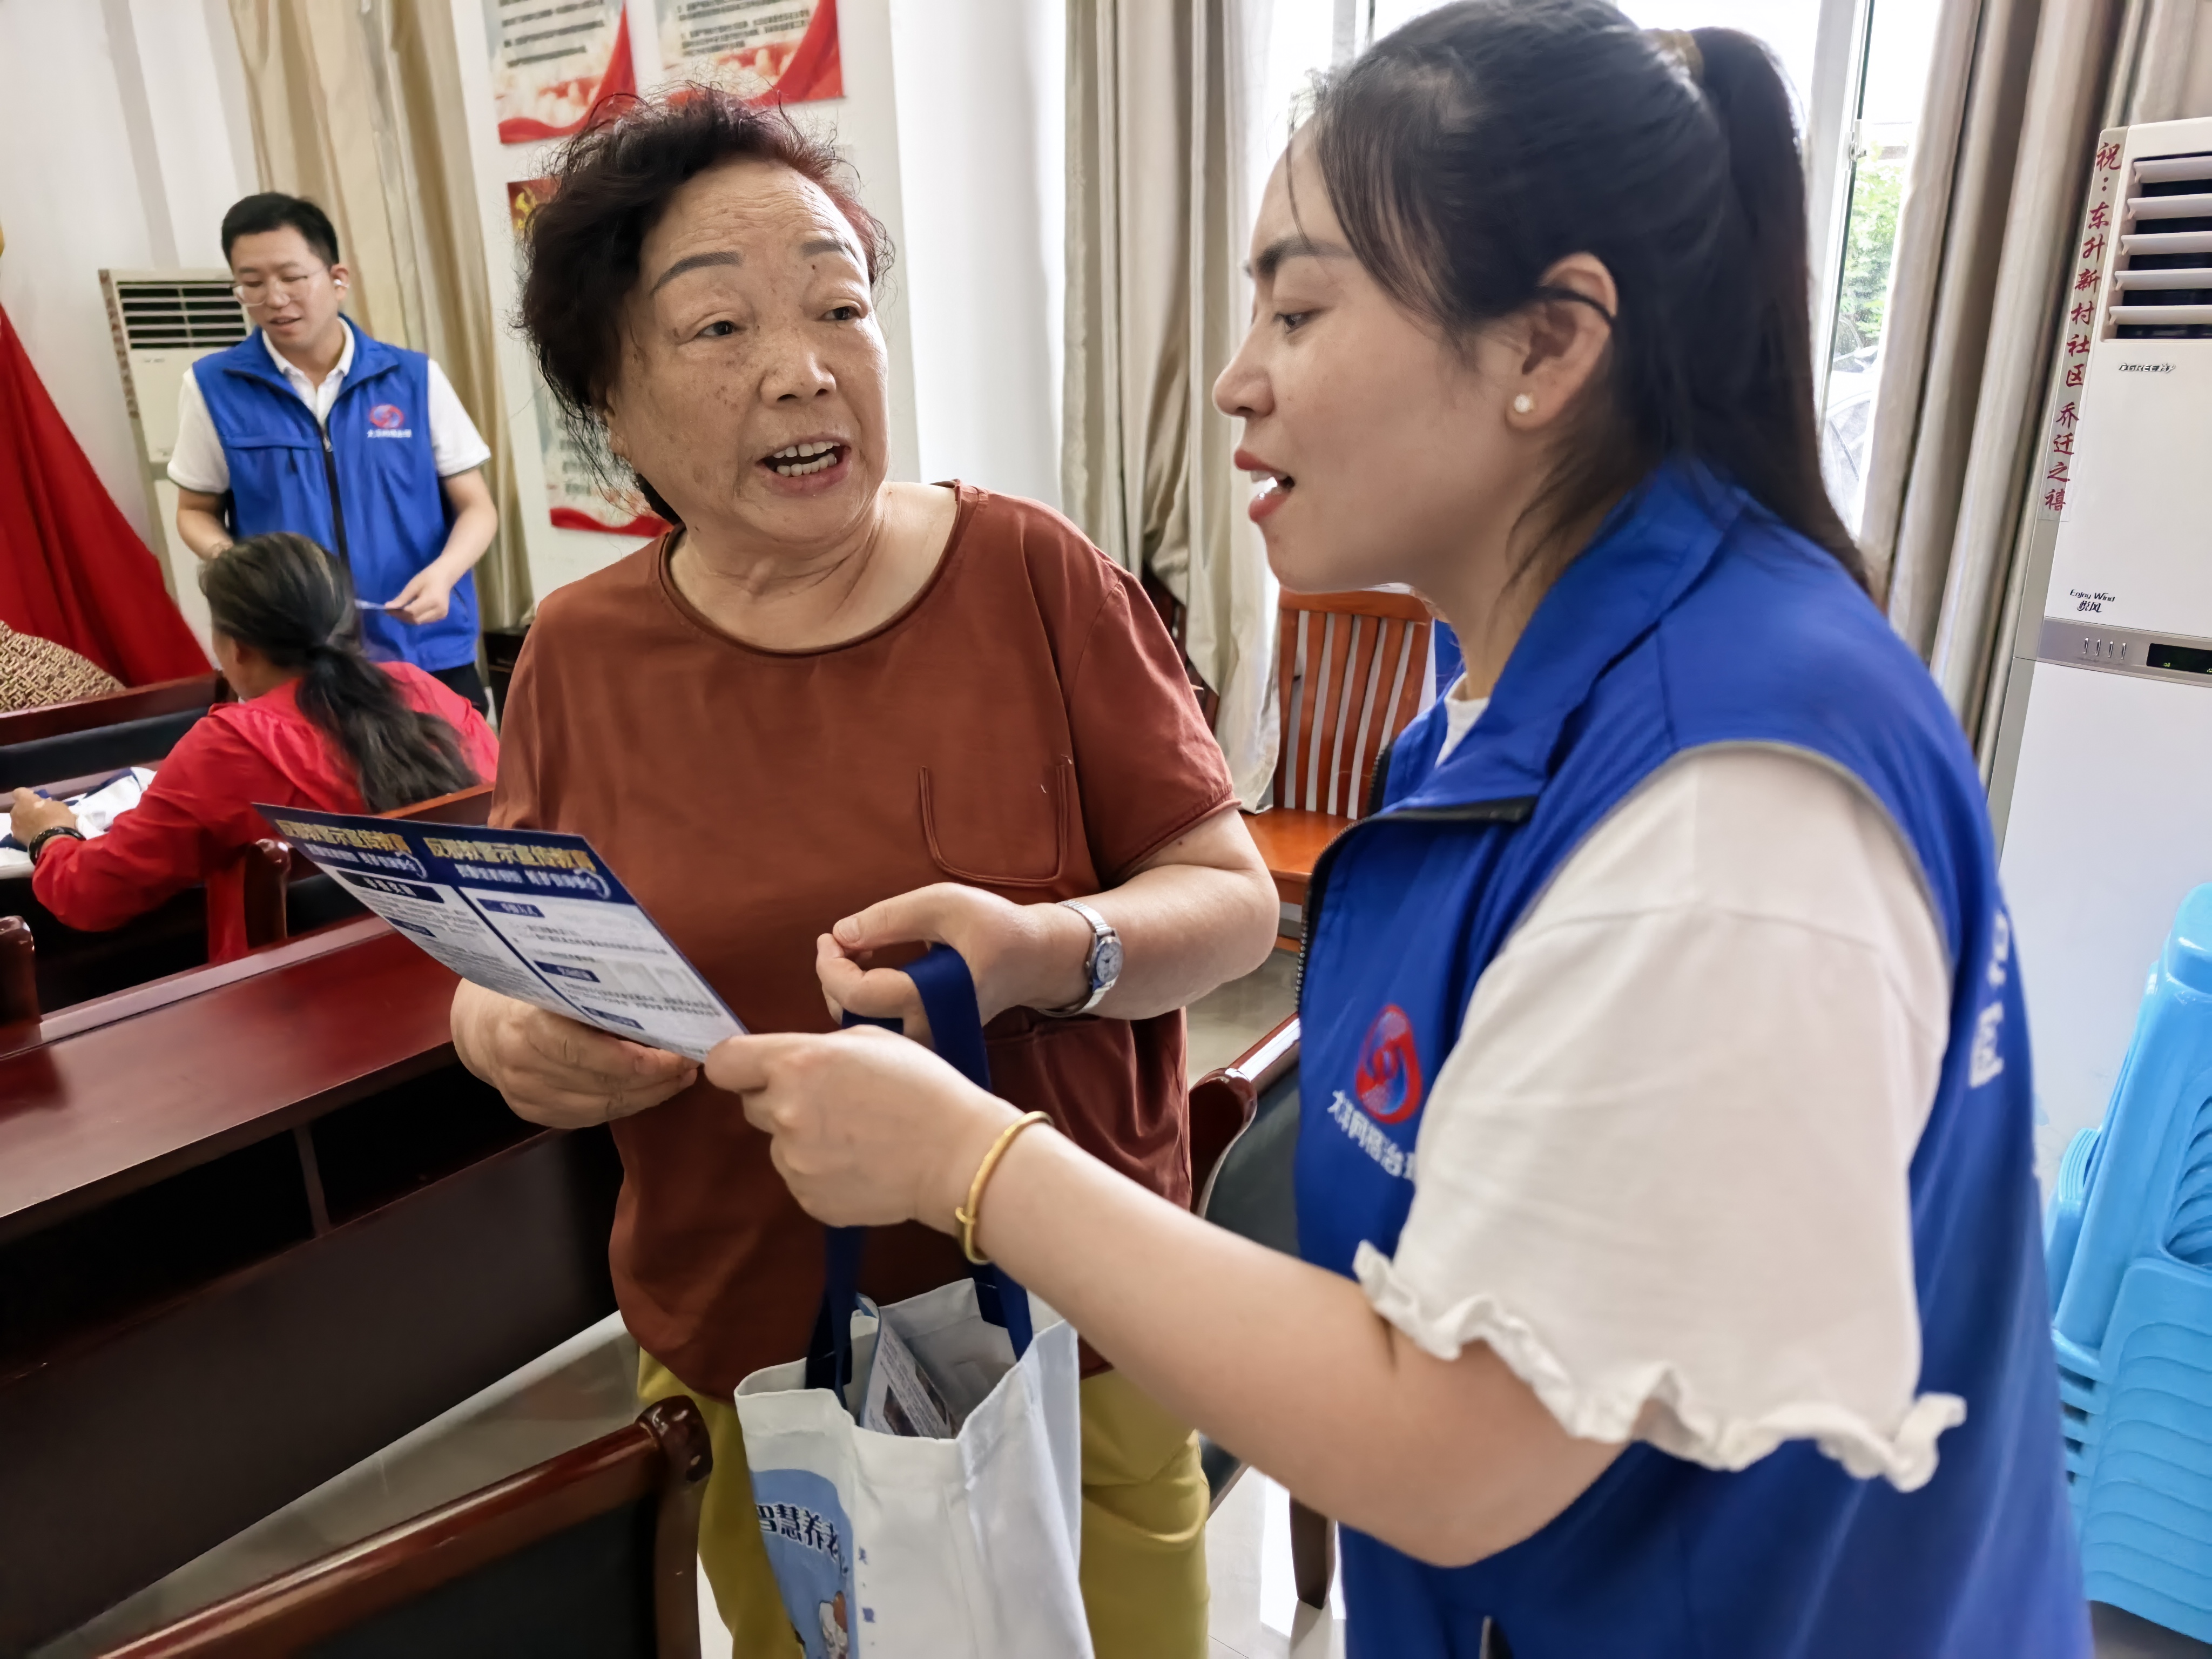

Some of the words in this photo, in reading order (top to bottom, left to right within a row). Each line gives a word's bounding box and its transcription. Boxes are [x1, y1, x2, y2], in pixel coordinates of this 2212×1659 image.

[2070, 589, 2092, 599] Enjoy
[2094, 592, 2115, 602] Wind
[2076, 601, 2102, 613] 悦风
